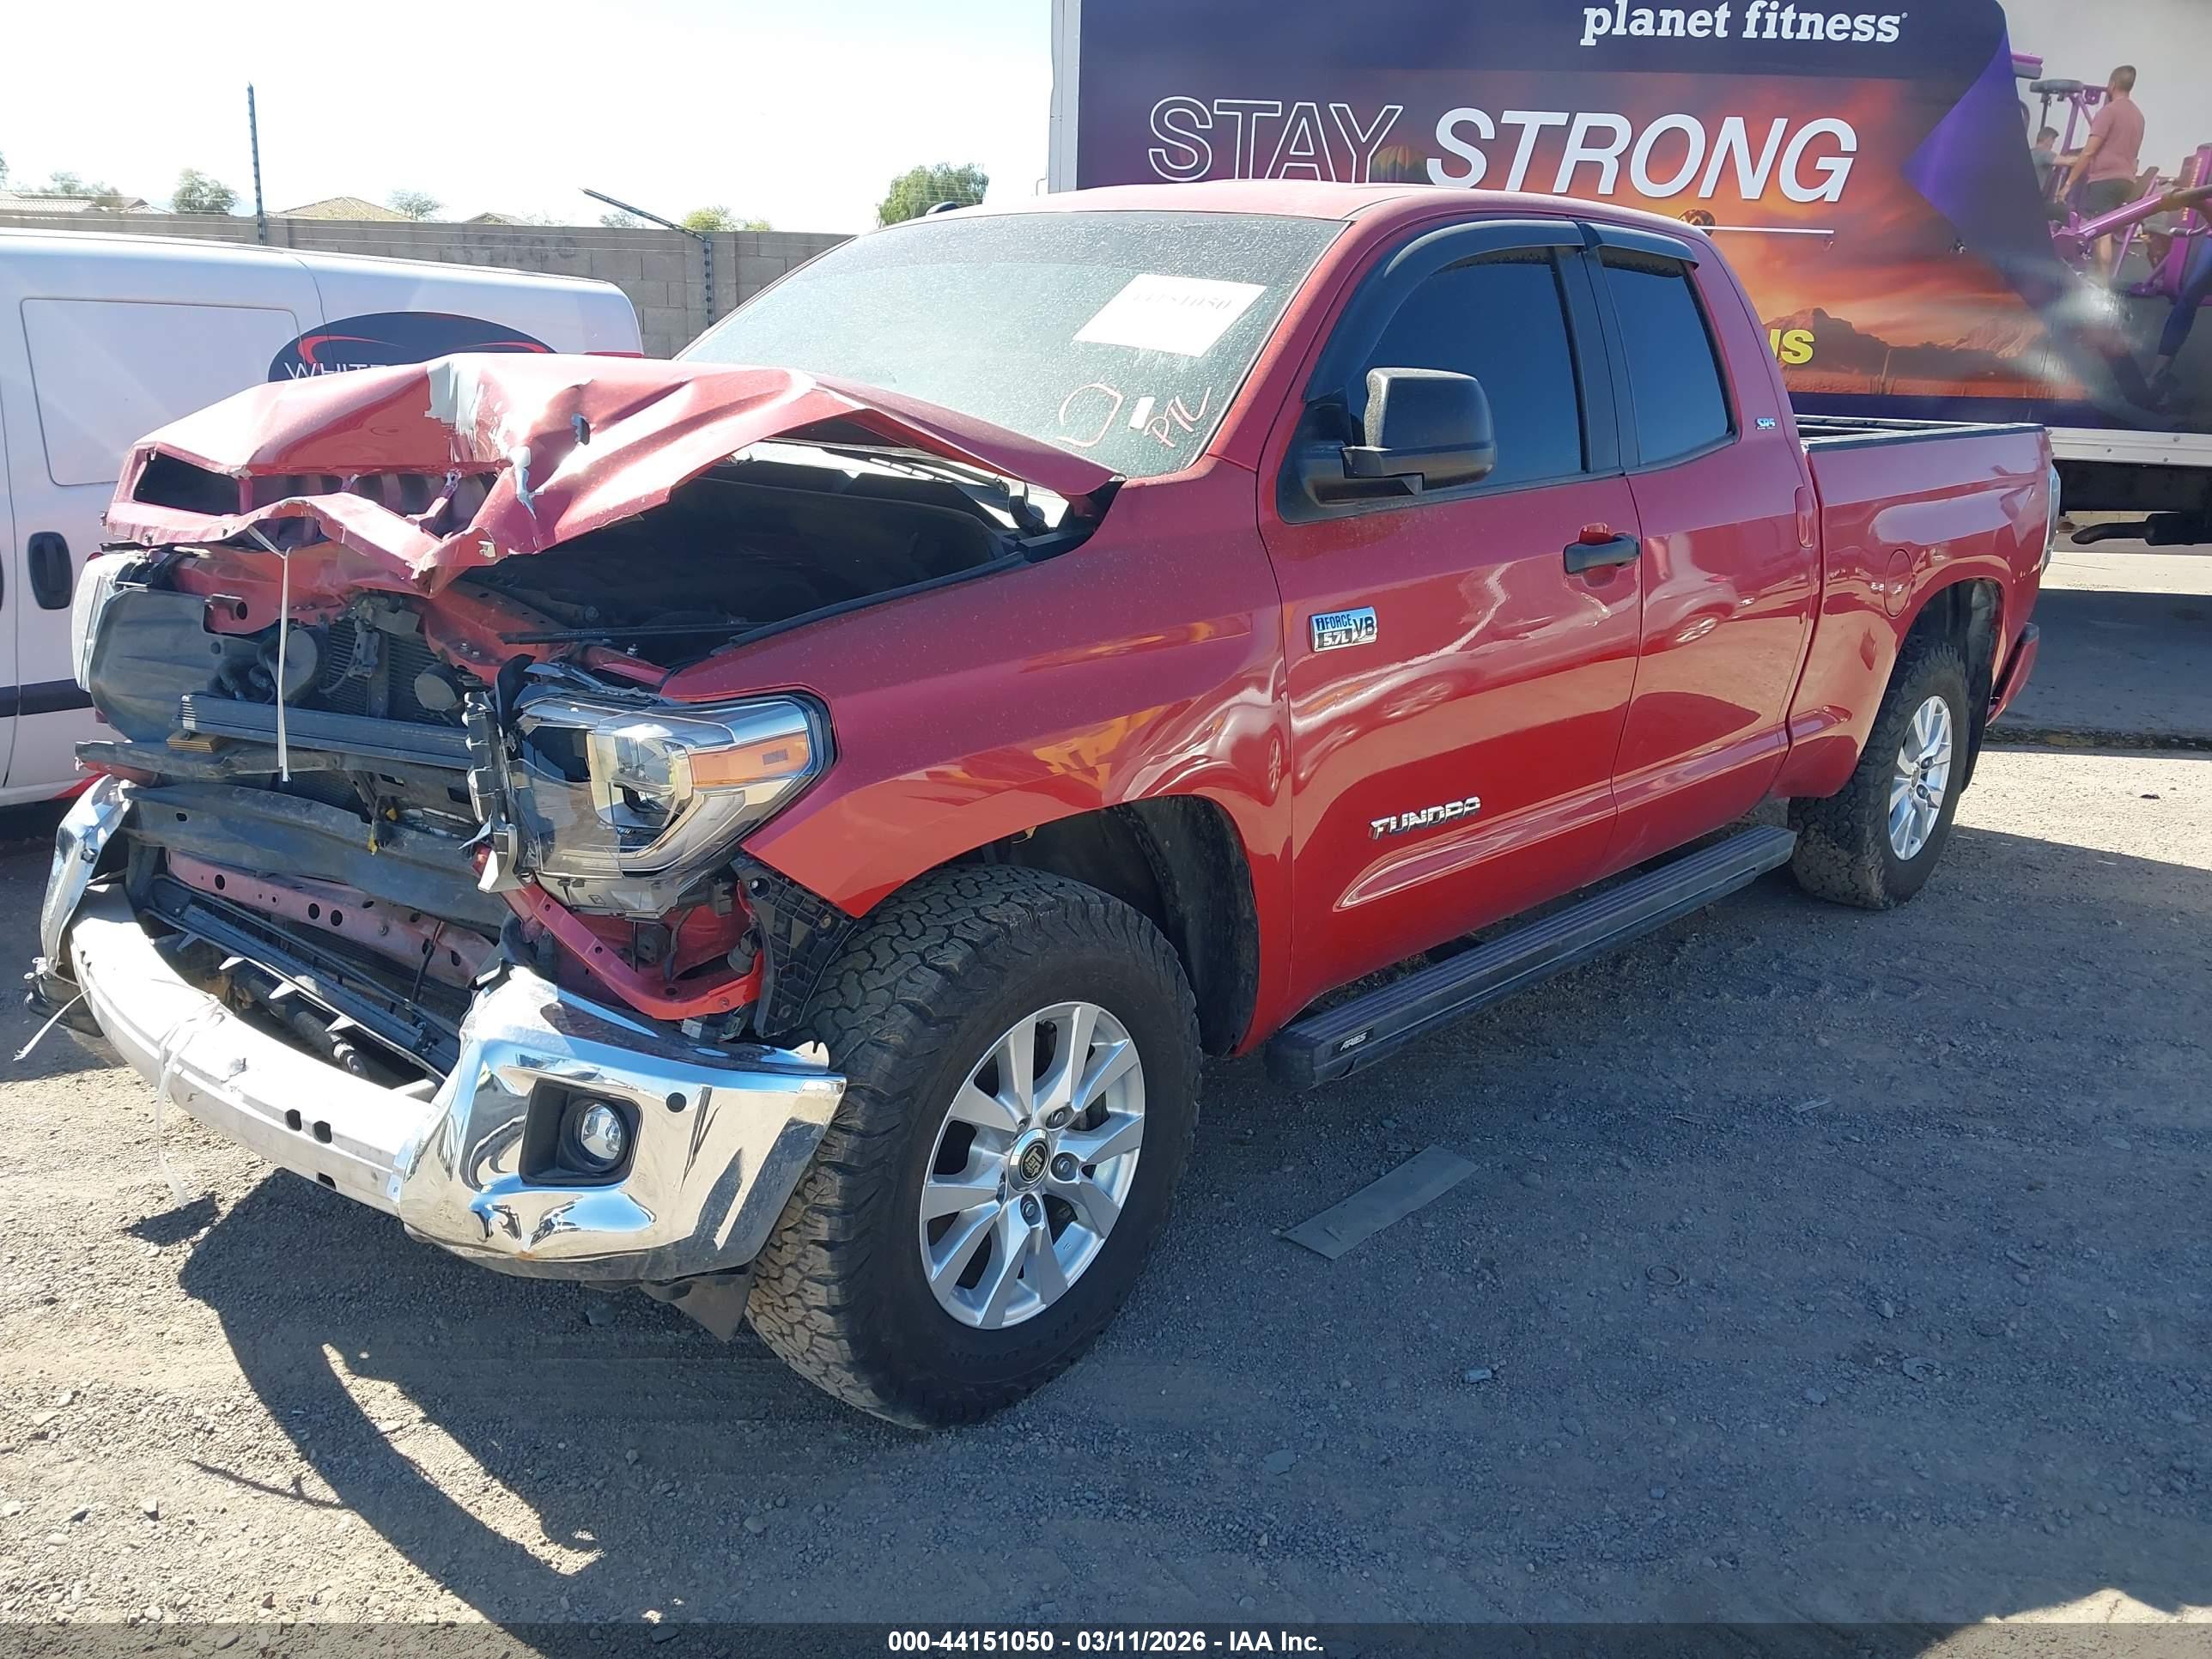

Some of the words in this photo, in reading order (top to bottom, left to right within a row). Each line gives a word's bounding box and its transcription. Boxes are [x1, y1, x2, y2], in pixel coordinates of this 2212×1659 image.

[1580, 0, 1731, 46] planet
[1741, 0, 1901, 43] fitness
[1148, 95, 1404, 184] STAY
[1426, 106, 1858, 203] STRONG
[1323, 629, 1351, 647] 5.7L
[1352, 616, 1375, 637] V8
[1369, 796, 1481, 840] TUNDRA
